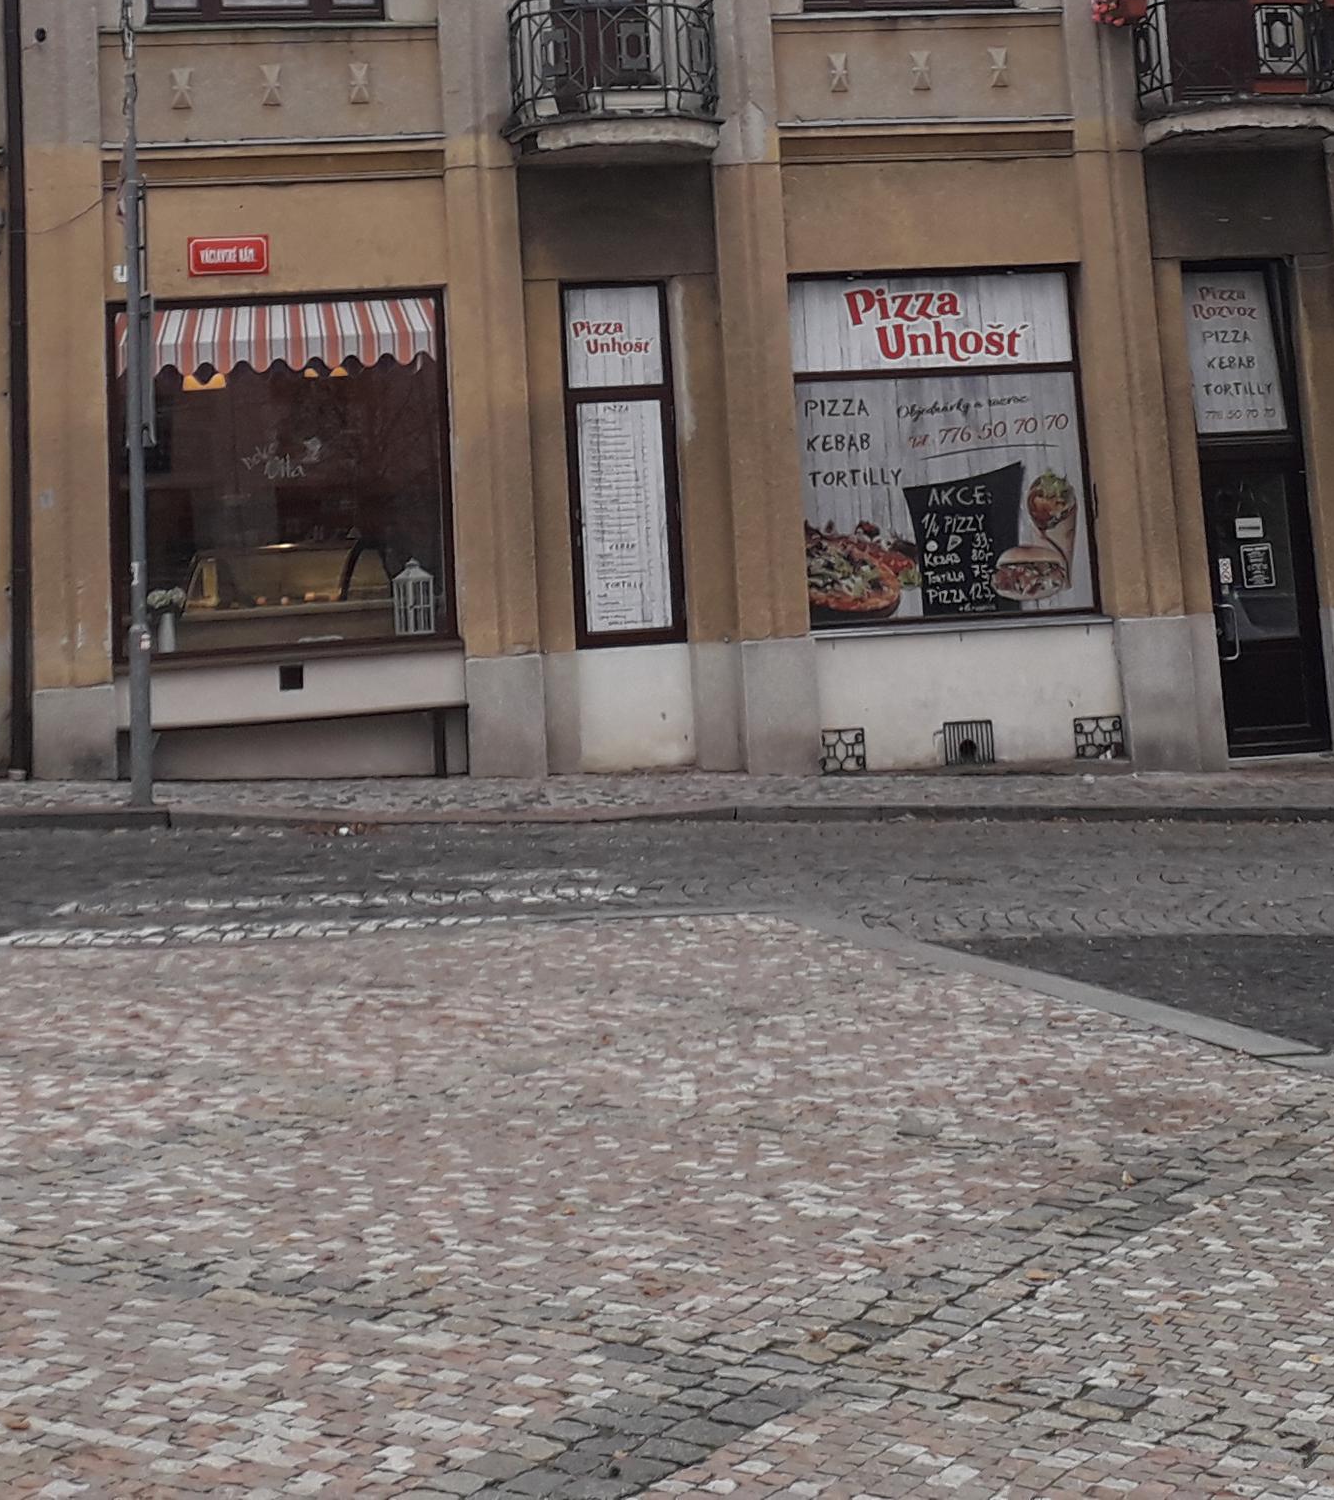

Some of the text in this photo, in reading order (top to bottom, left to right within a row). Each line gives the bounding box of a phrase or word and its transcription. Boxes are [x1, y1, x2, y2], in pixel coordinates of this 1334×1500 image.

[845, 289, 960, 325] Pizza
[572, 321, 623, 338] Pizza
[1202, 330, 1252, 343] PIZZA
[1207, 356, 1256, 370] KEBAB
[1203, 382, 1273, 396] TORTILLY
[805, 400, 870, 418] PIZZA
[939, 426, 971, 444] 776
[978, 421, 1007, 440] 50
[1014, 417, 1038, 434] 70
[1045, 413, 1069, 430] 70
[807, 434, 870, 451] KEBAB
[809, 469, 902, 487] TORTILLY
[928, 485, 992, 507] AKCE:
[922, 513, 985, 538] 1/4 PIZZY
